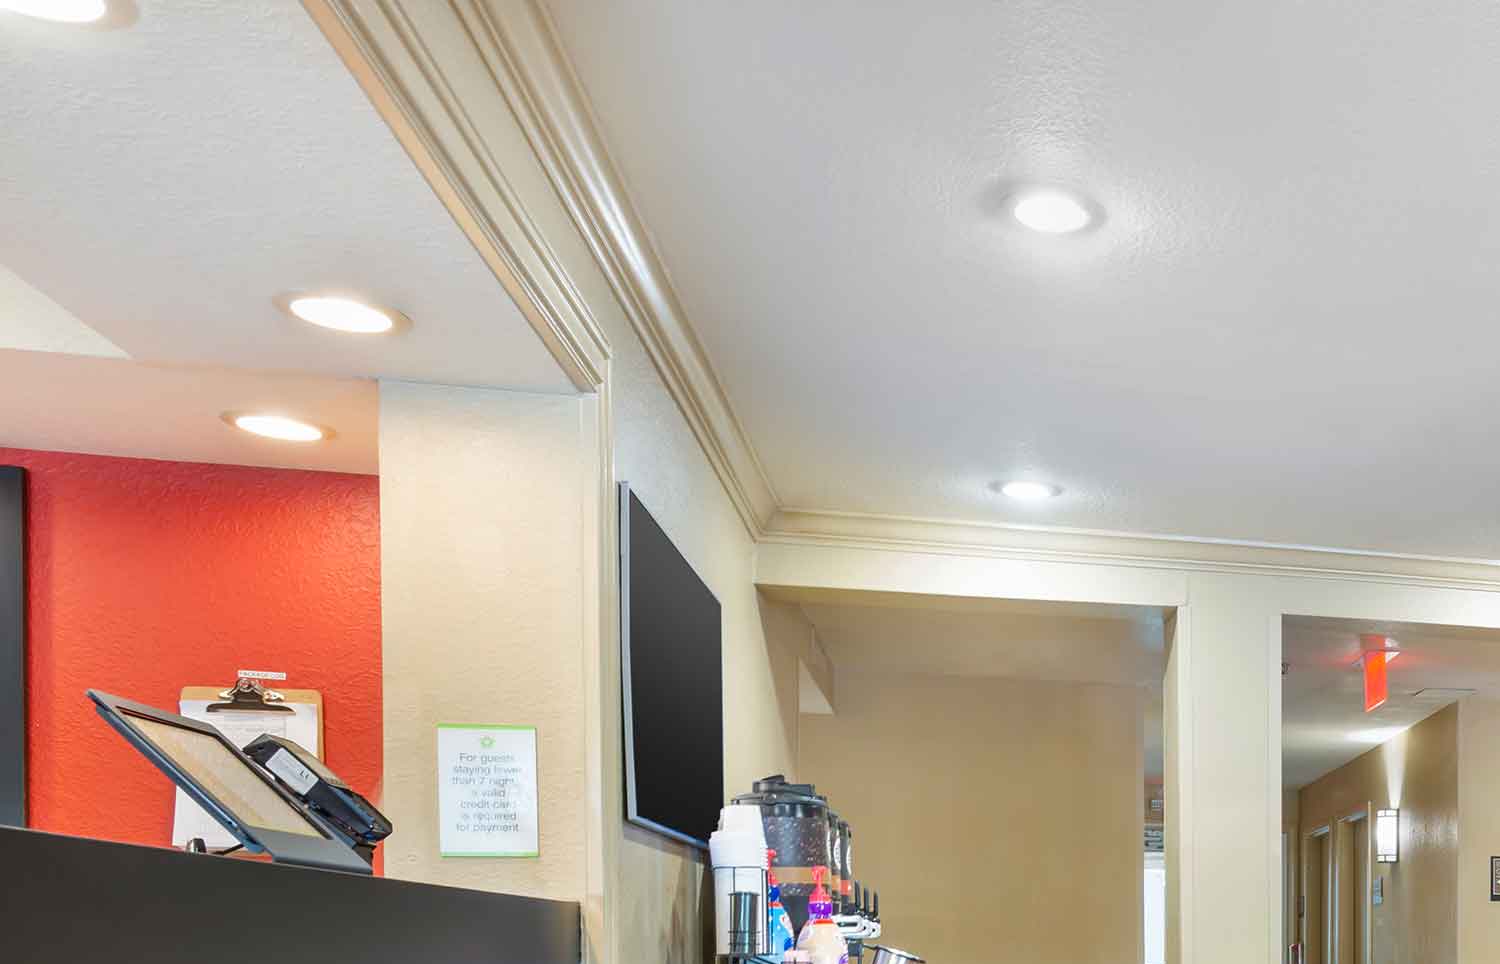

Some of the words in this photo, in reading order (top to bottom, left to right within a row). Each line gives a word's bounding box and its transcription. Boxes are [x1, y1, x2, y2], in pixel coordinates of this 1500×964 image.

[459, 752, 477, 762] For
[493, 765, 522, 774] fwer
[488, 776, 519, 788] night
[460, 799, 490, 809] credit
[493, 800, 516, 809] car
[473, 812, 517, 823] reqired
[473, 823, 519, 833] payment
